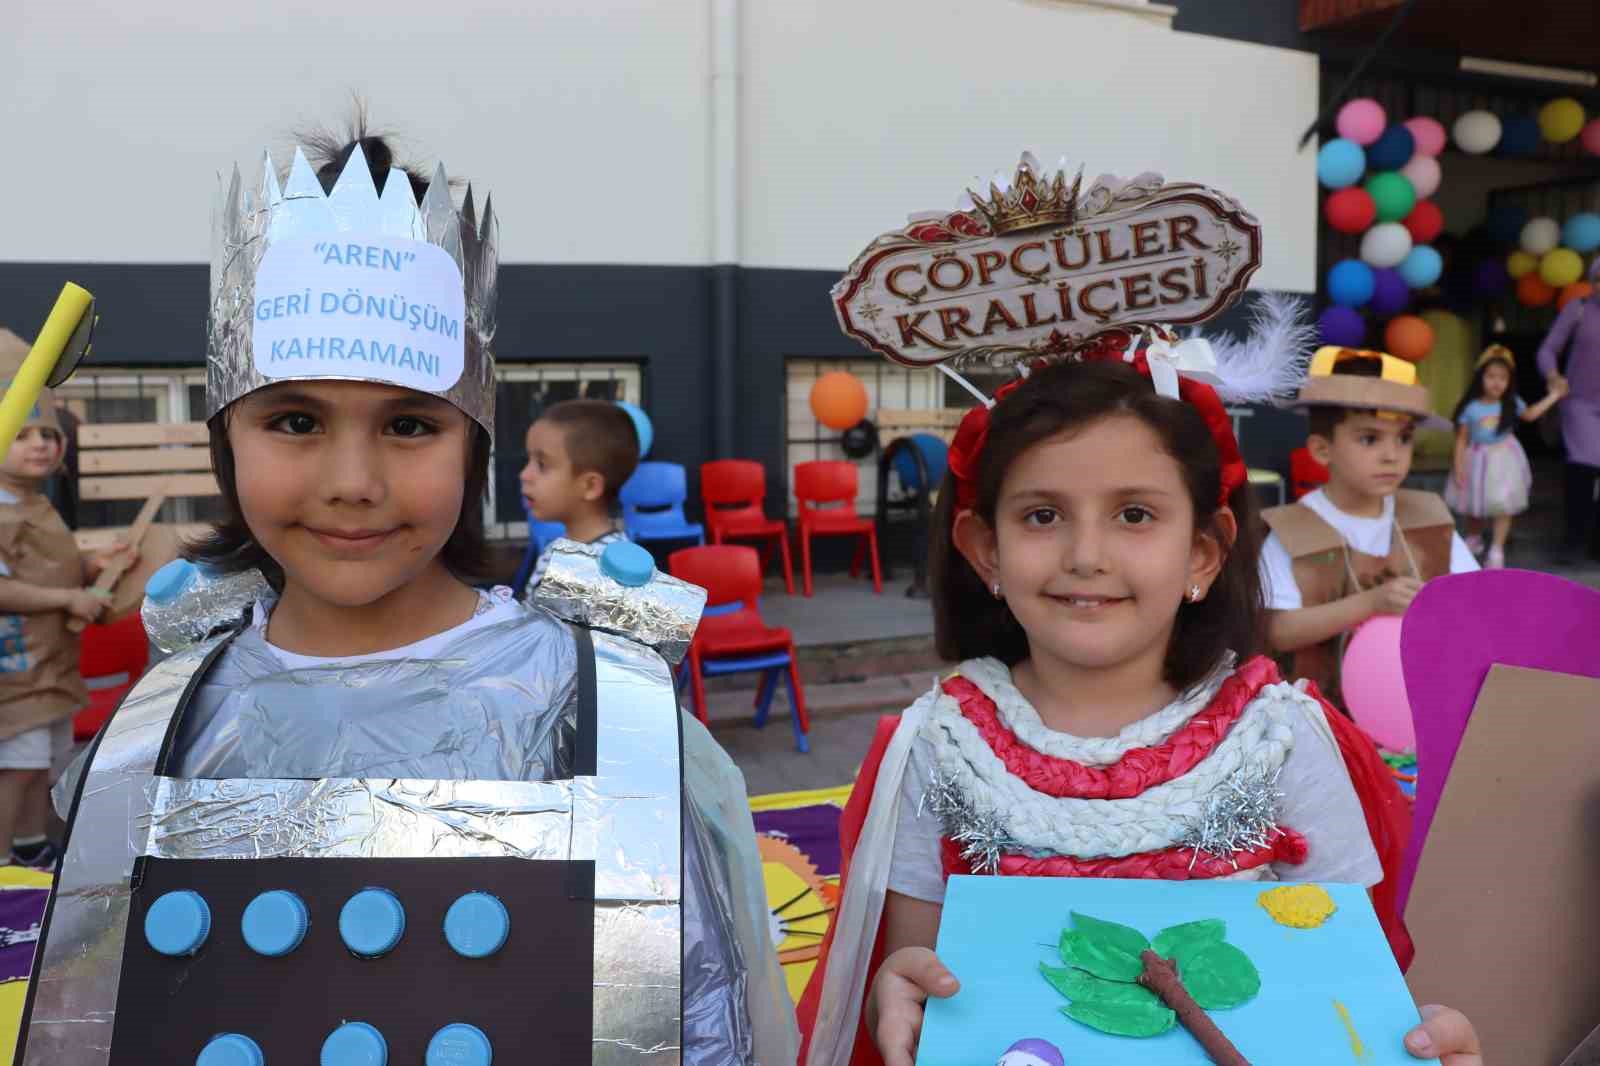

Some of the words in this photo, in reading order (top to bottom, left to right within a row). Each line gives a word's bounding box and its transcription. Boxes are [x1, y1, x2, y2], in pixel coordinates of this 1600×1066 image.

[885, 214, 1215, 305] ÇÖPÇÜLER
[256, 288, 312, 321] GERİ
[320, 288, 459, 340] DÖNÜŞÜM
[893, 257, 1211, 351] KRALİÇESİ
[270, 336, 440, 377] KAHRAMANI
